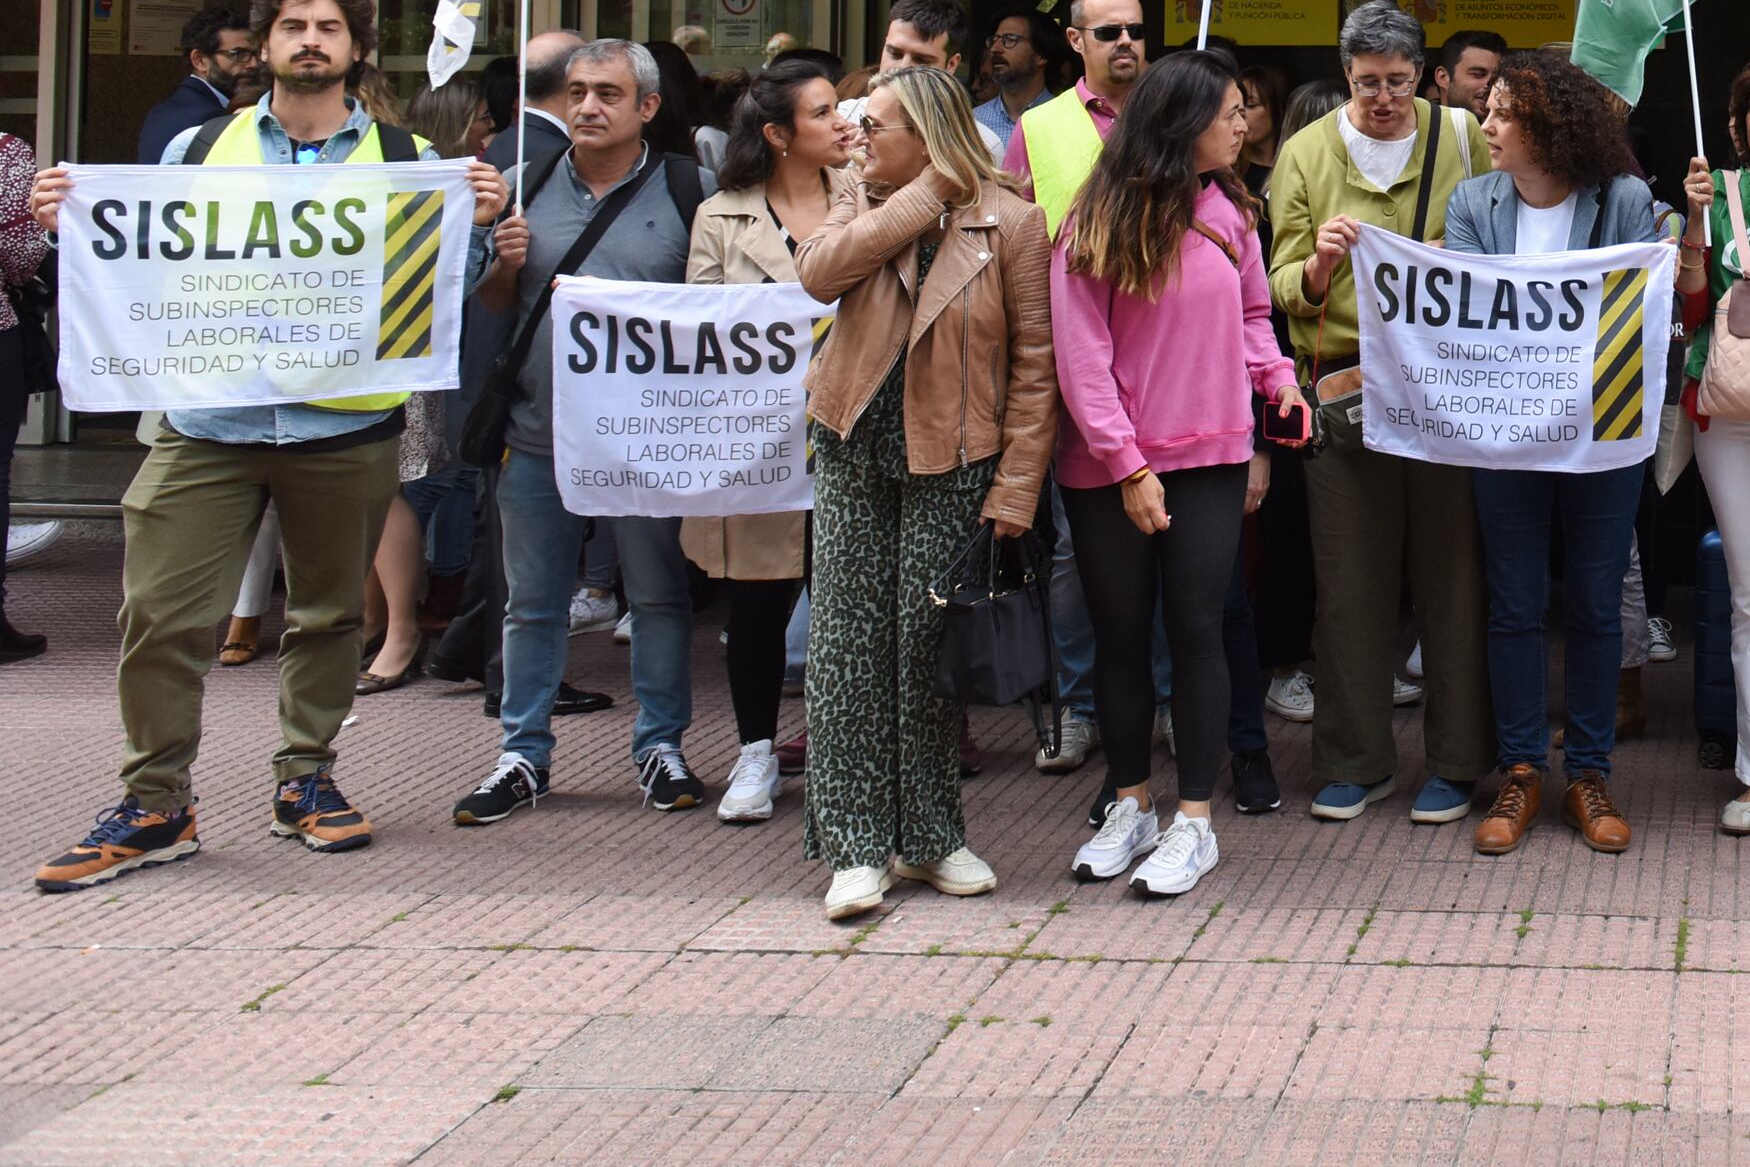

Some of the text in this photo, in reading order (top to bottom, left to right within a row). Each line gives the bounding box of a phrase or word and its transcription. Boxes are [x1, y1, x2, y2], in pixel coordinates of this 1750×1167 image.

[1236, 11, 1273, 19] FUNCIÓN
[1274, 11, 1306, 20] PÚBLICA
[1462, 12, 1537, 21] TRANSFORMACIÓN
[1537, 12, 1567, 21] DIGITAL
[1466, 3, 1503, 11] ASUNTOS
[1505, 2, 1560, 11] ECONÓMICOS
[91, 196, 367, 261] SISLASS
[181, 269, 366, 292] SINDICATO DE
[1373, 262, 1589, 332] SISLASS
[129, 296, 363, 322] SUBINSPECTORES
[167, 322, 362, 348] LABORALES DE
[567, 311, 797, 375] SISLASS
[91, 349, 360, 377] SEGURIDAD Y SALUD
[1437, 341, 1582, 364] SINDICATO DE
[1400, 364, 1579, 390] SUBINSPECTORES
[640, 388, 792, 409] SINDICATO DE
[1424, 393, 1577, 417] LABORALES DE
[595, 415, 791, 436] SUBINSPECTORES
[1491, 424, 1503, 442] Y
[1508, 424, 1578, 443] SALUD
[626, 441, 792, 463] LABORALES DE
[570, 465, 791, 489] SEGURIDAD Y SALUD
